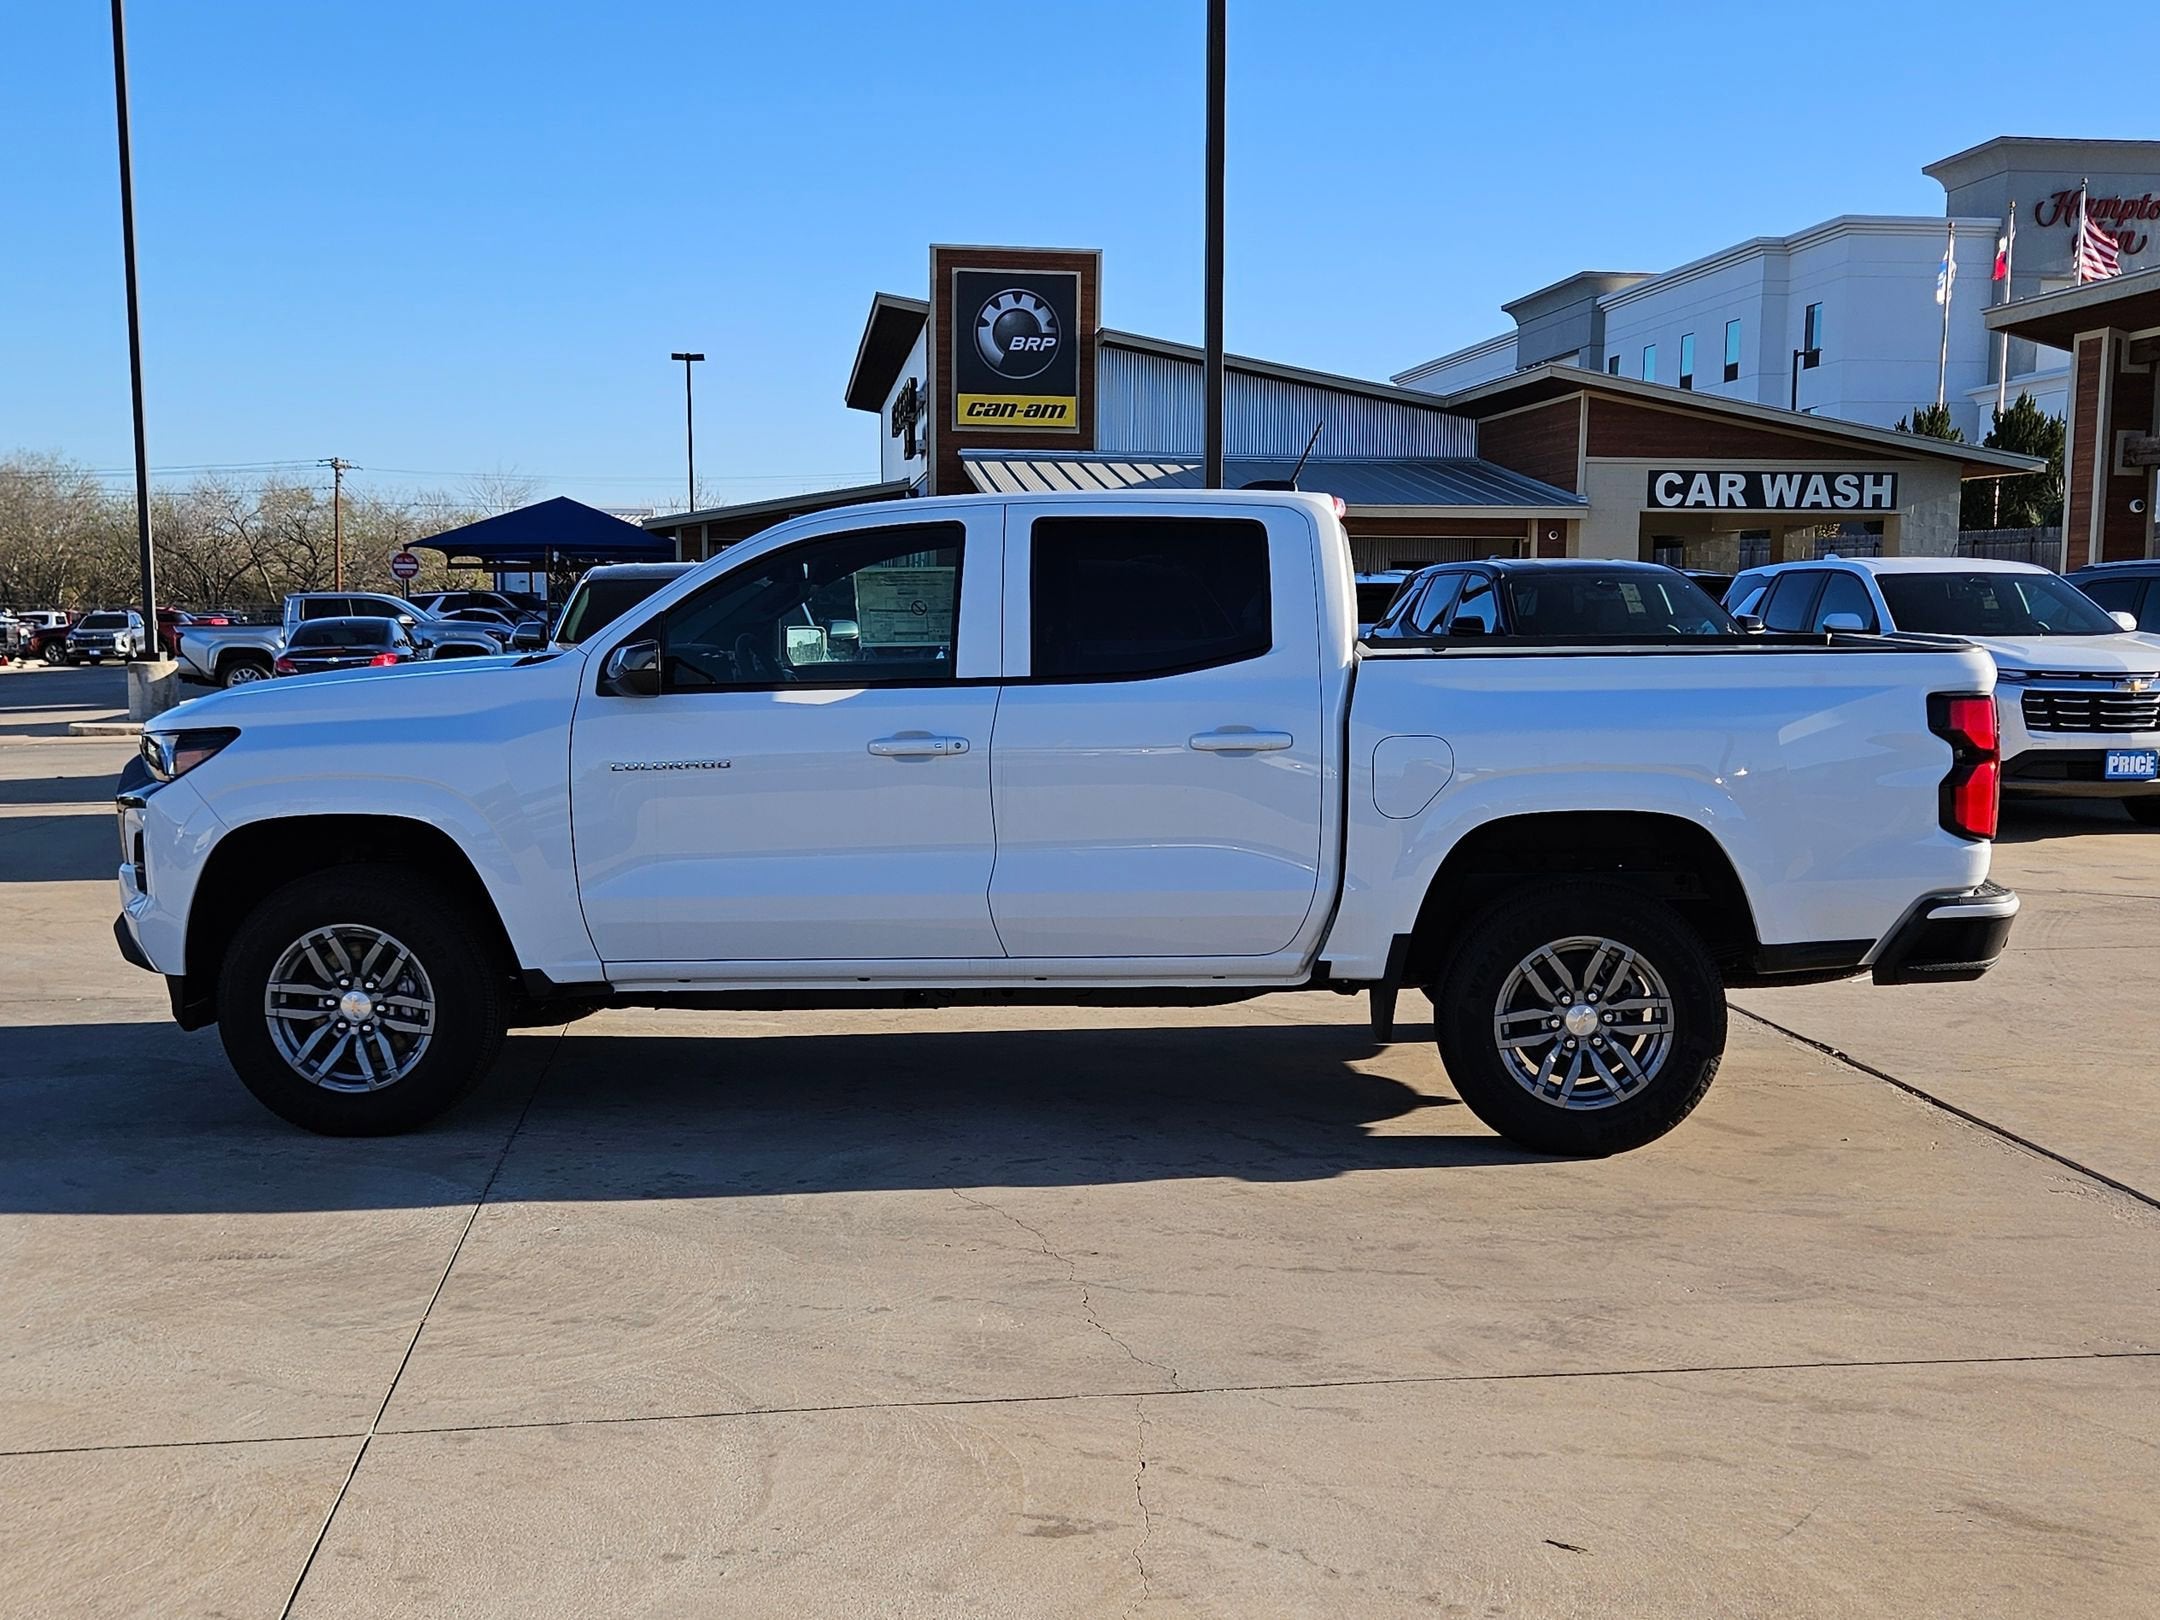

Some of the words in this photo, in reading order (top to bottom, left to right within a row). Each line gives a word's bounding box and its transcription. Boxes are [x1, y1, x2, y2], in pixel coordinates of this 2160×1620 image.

[1009, 336, 1056, 351] BRP
[966, 402, 1067, 419] can-am
[1655, 472, 1747, 507] CAR
[1761, 474, 1893, 508] WASH
[610, 759, 731, 772] COLORADO
[2107, 755, 2155, 773] PRICE
